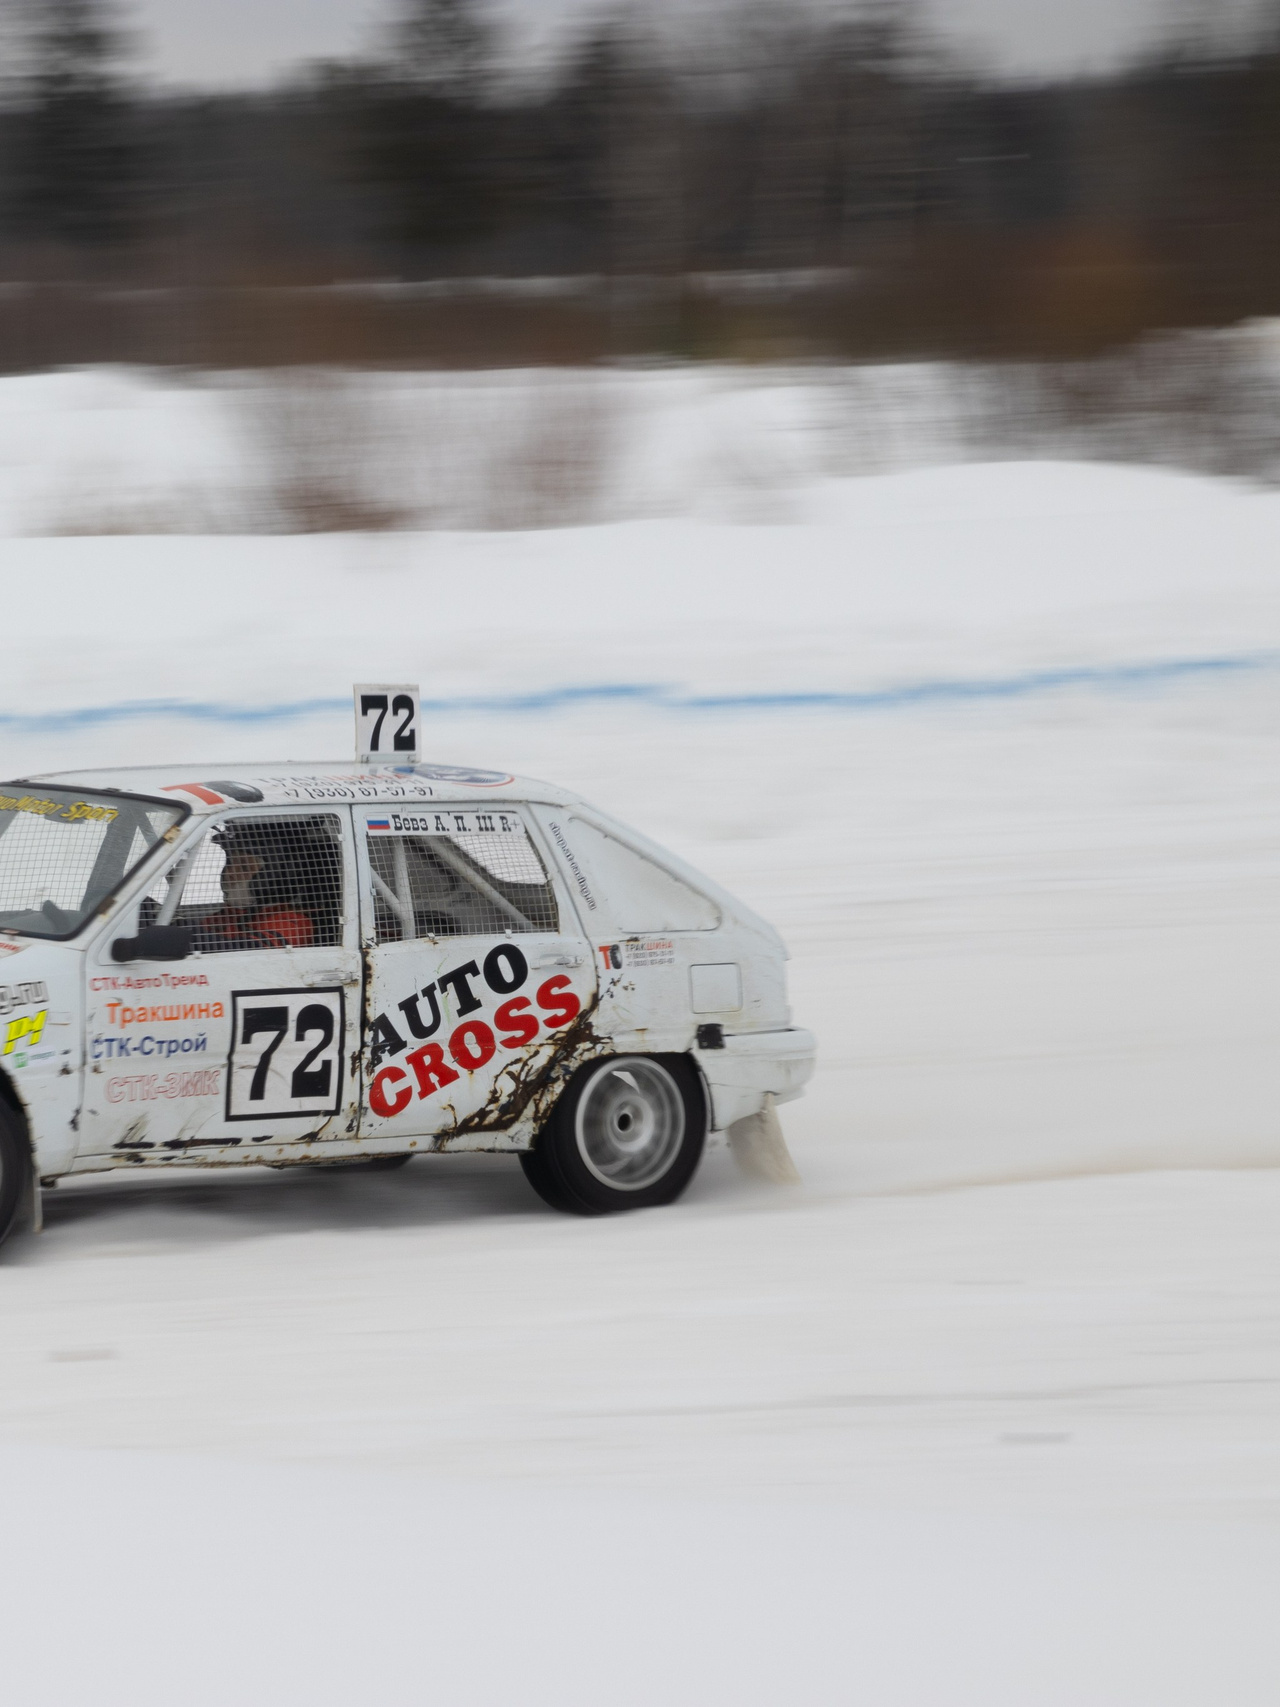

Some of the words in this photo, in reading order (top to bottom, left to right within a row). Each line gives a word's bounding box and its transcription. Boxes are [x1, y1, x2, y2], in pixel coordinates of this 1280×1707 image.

[361, 694, 416, 752] 72
[392, 814, 429, 832] Бевз
[106, 1001, 224, 1029] Тракшина
[370, 943, 528, 1067] AUTO
[91, 1033, 207, 1059] СТК-Строй
[241, 1003, 335, 1101] 72
[369, 974, 581, 1118] CROSS
